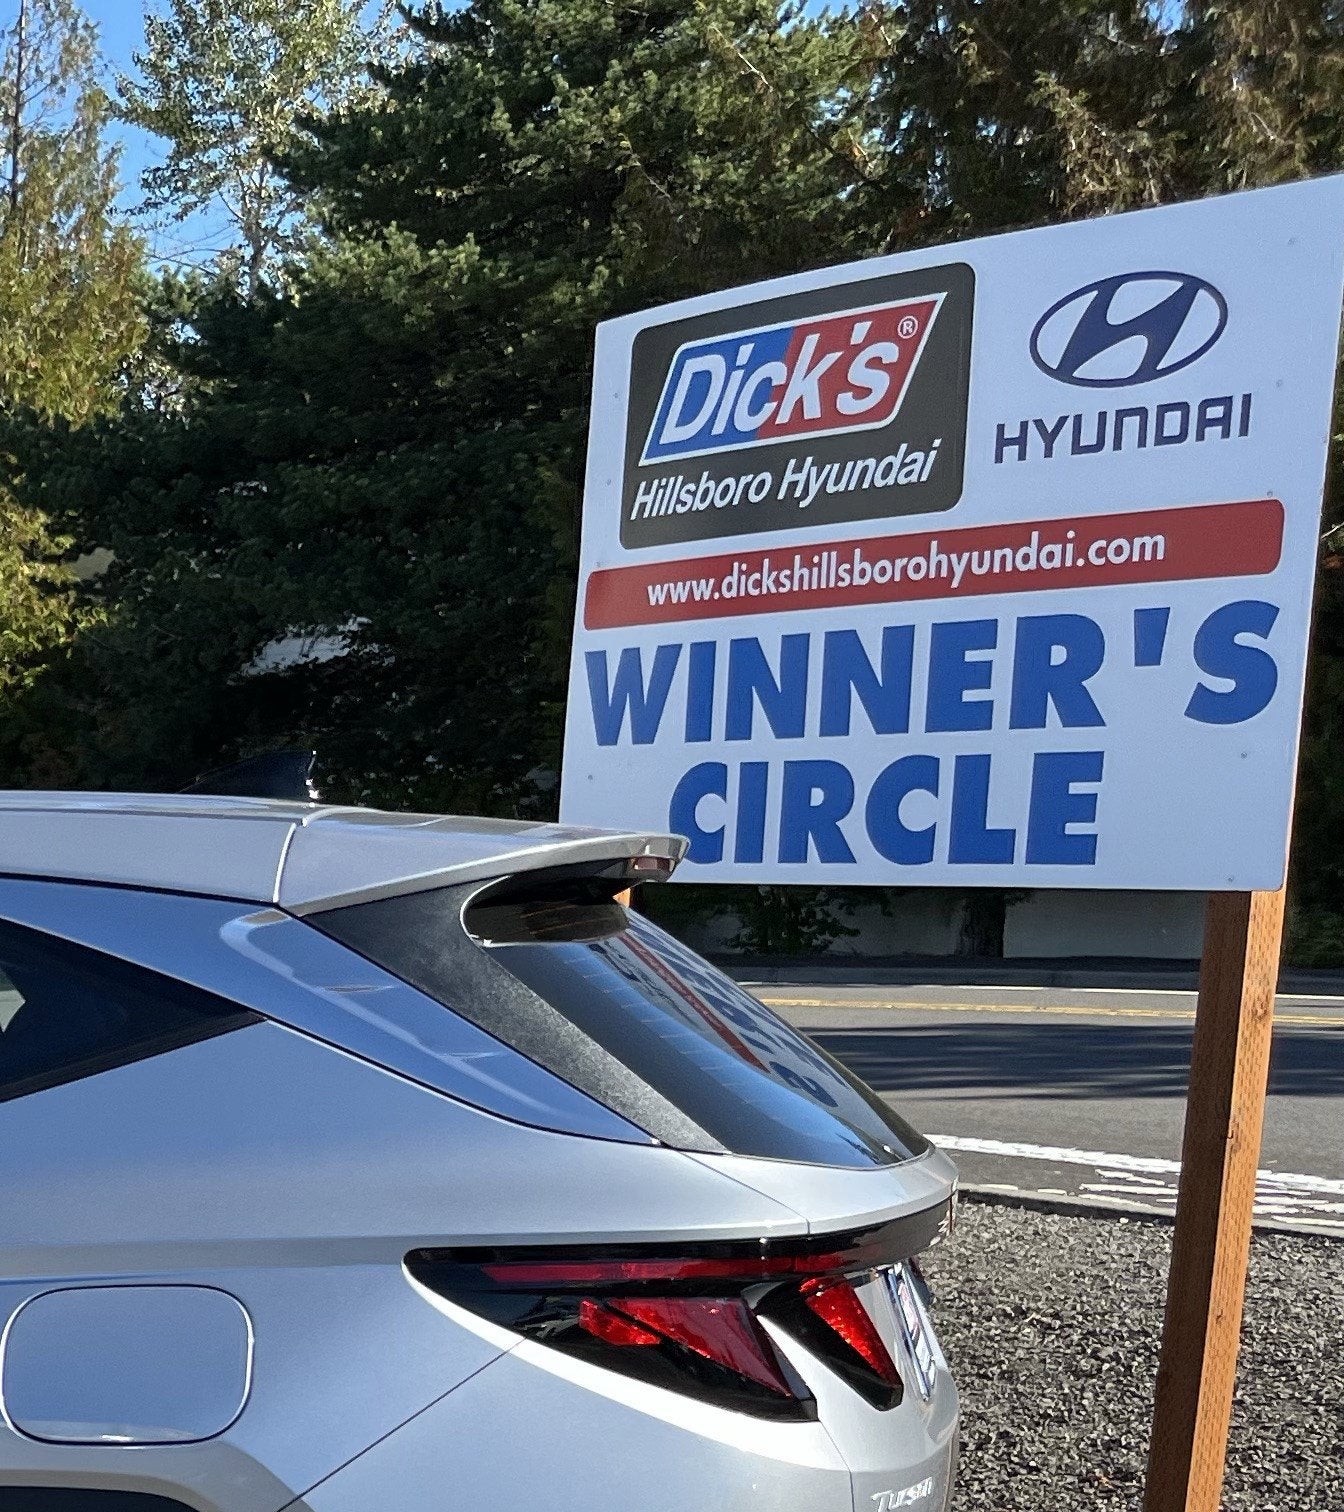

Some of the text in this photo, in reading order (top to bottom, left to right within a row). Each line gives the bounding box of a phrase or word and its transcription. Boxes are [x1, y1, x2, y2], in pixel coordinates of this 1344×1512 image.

[994, 393, 1252, 464] HYUNDAI
[630, 438, 942, 520] Hillsboro Hyundai
[647, 529, 1166, 607] www.dickshillsborohyundai.com
[584, 600, 1281, 747] WINNER'S
[669, 750, 1106, 866] CIRCLE
